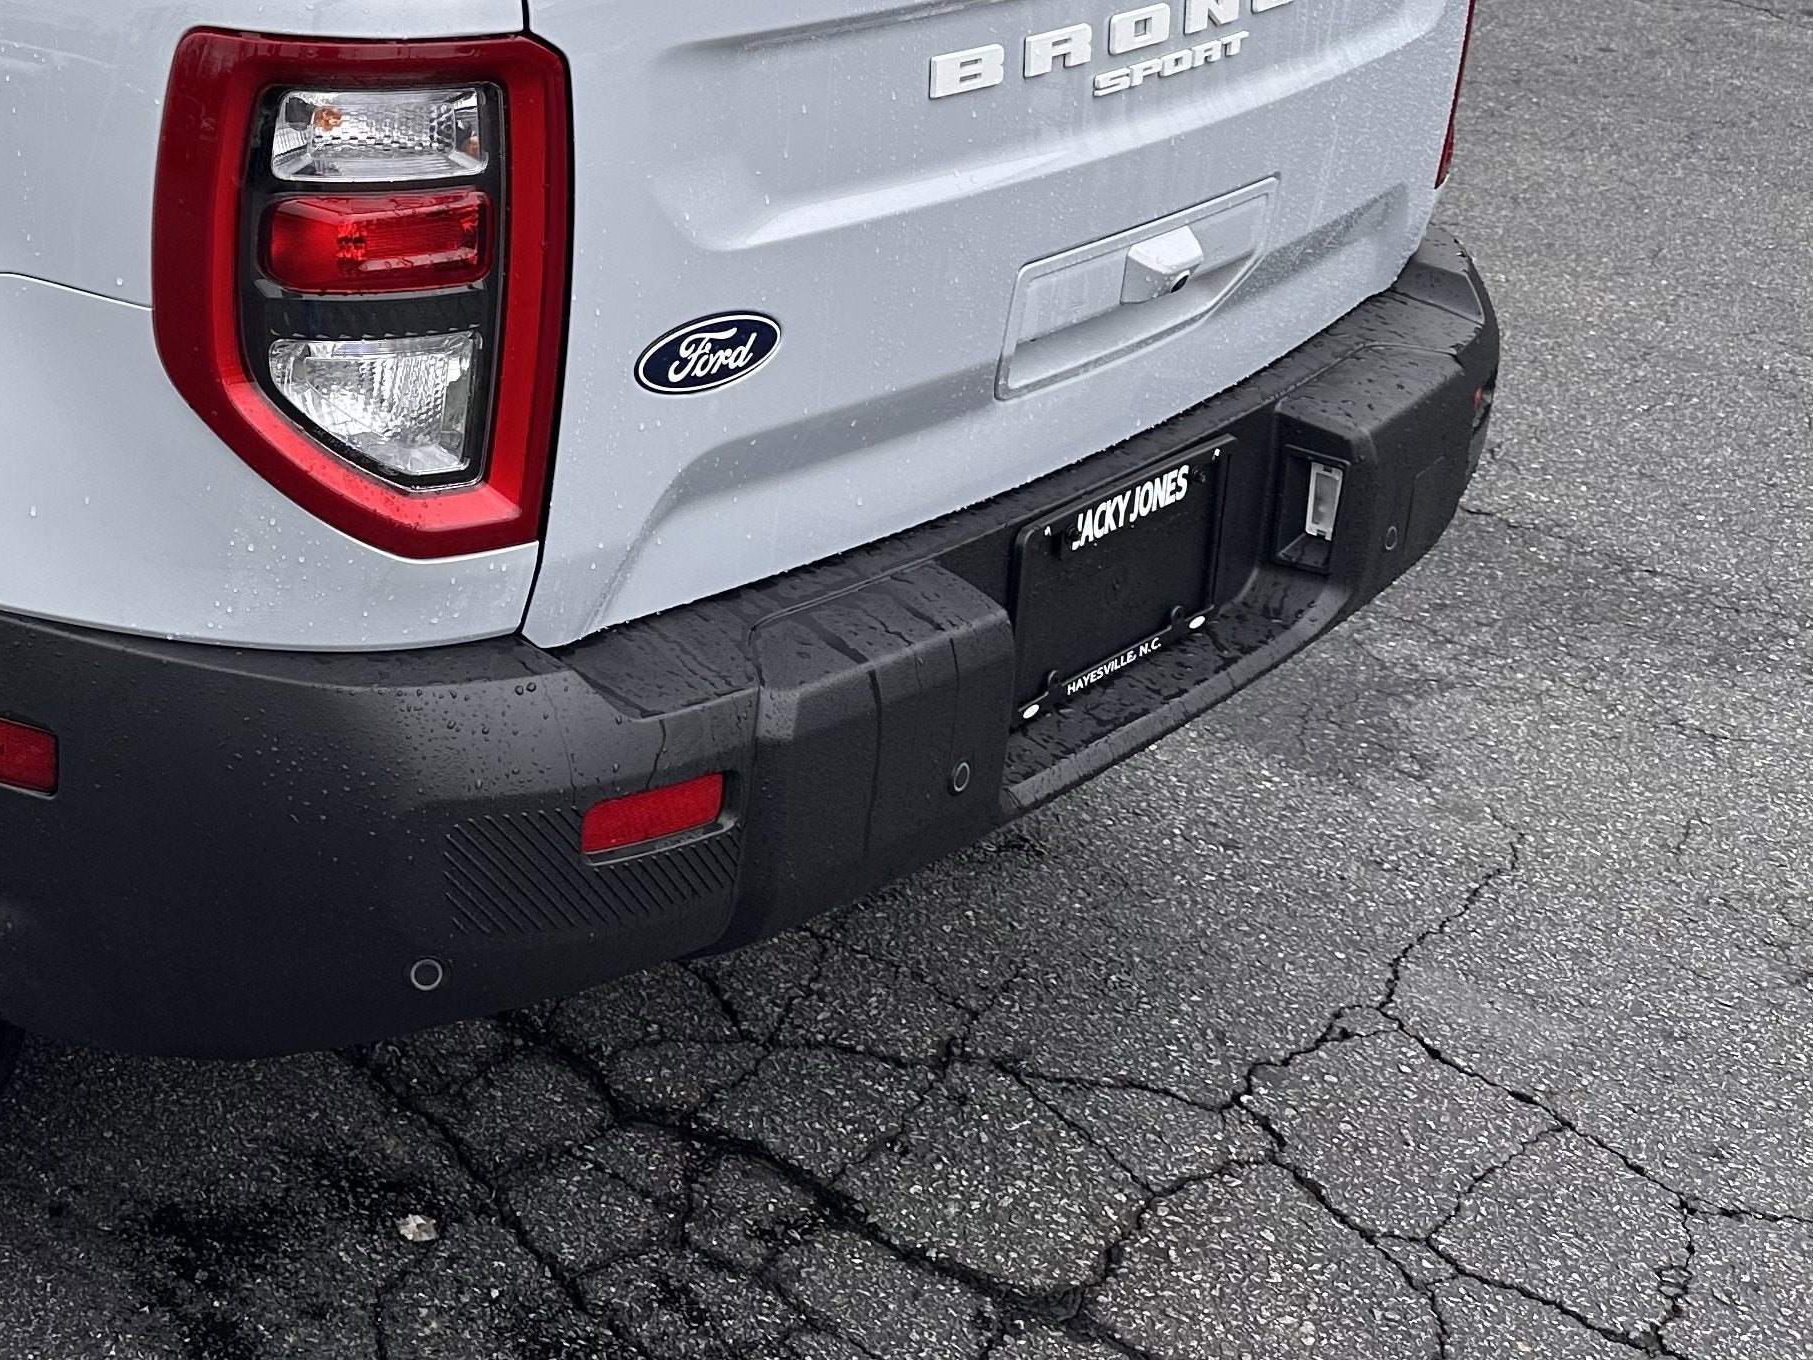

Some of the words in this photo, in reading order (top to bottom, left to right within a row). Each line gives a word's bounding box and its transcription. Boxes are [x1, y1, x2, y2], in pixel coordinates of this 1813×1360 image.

[1092, 30, 1250, 97] SPORT
[667, 327, 758, 383] Ford
[1071, 491, 1132, 551] JACKY
[1129, 464, 1190, 523] JONES
[1138, 636, 1162, 658] N.C.
